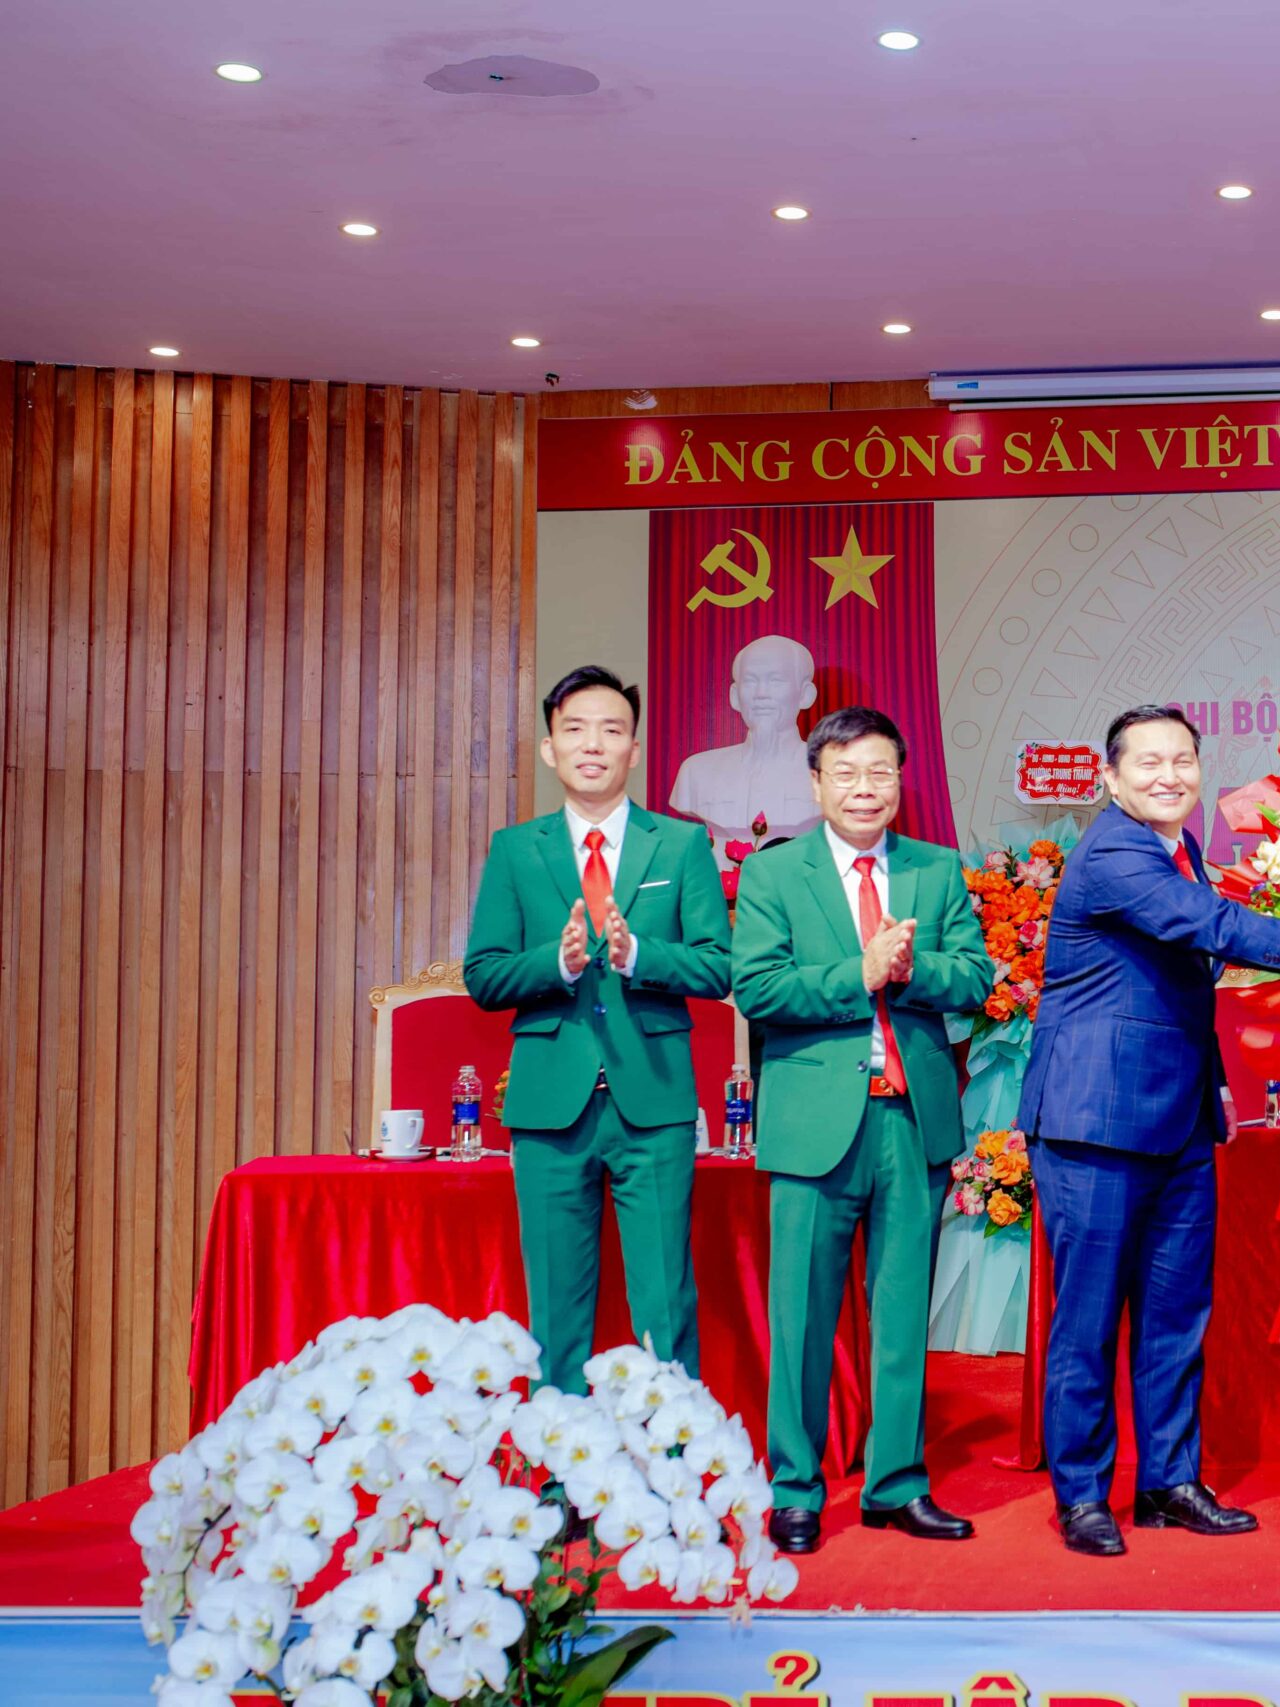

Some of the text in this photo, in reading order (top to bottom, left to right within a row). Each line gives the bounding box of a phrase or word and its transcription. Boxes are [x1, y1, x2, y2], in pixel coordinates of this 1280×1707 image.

[624, 430, 793, 485] ĐẢNG
[811, 425, 983, 489] CỘNG
[1003, 417, 1119, 475] SẢN
[1137, 415, 1280, 478] VIỆT
[1232, 692, 1278, 742] BỘ
